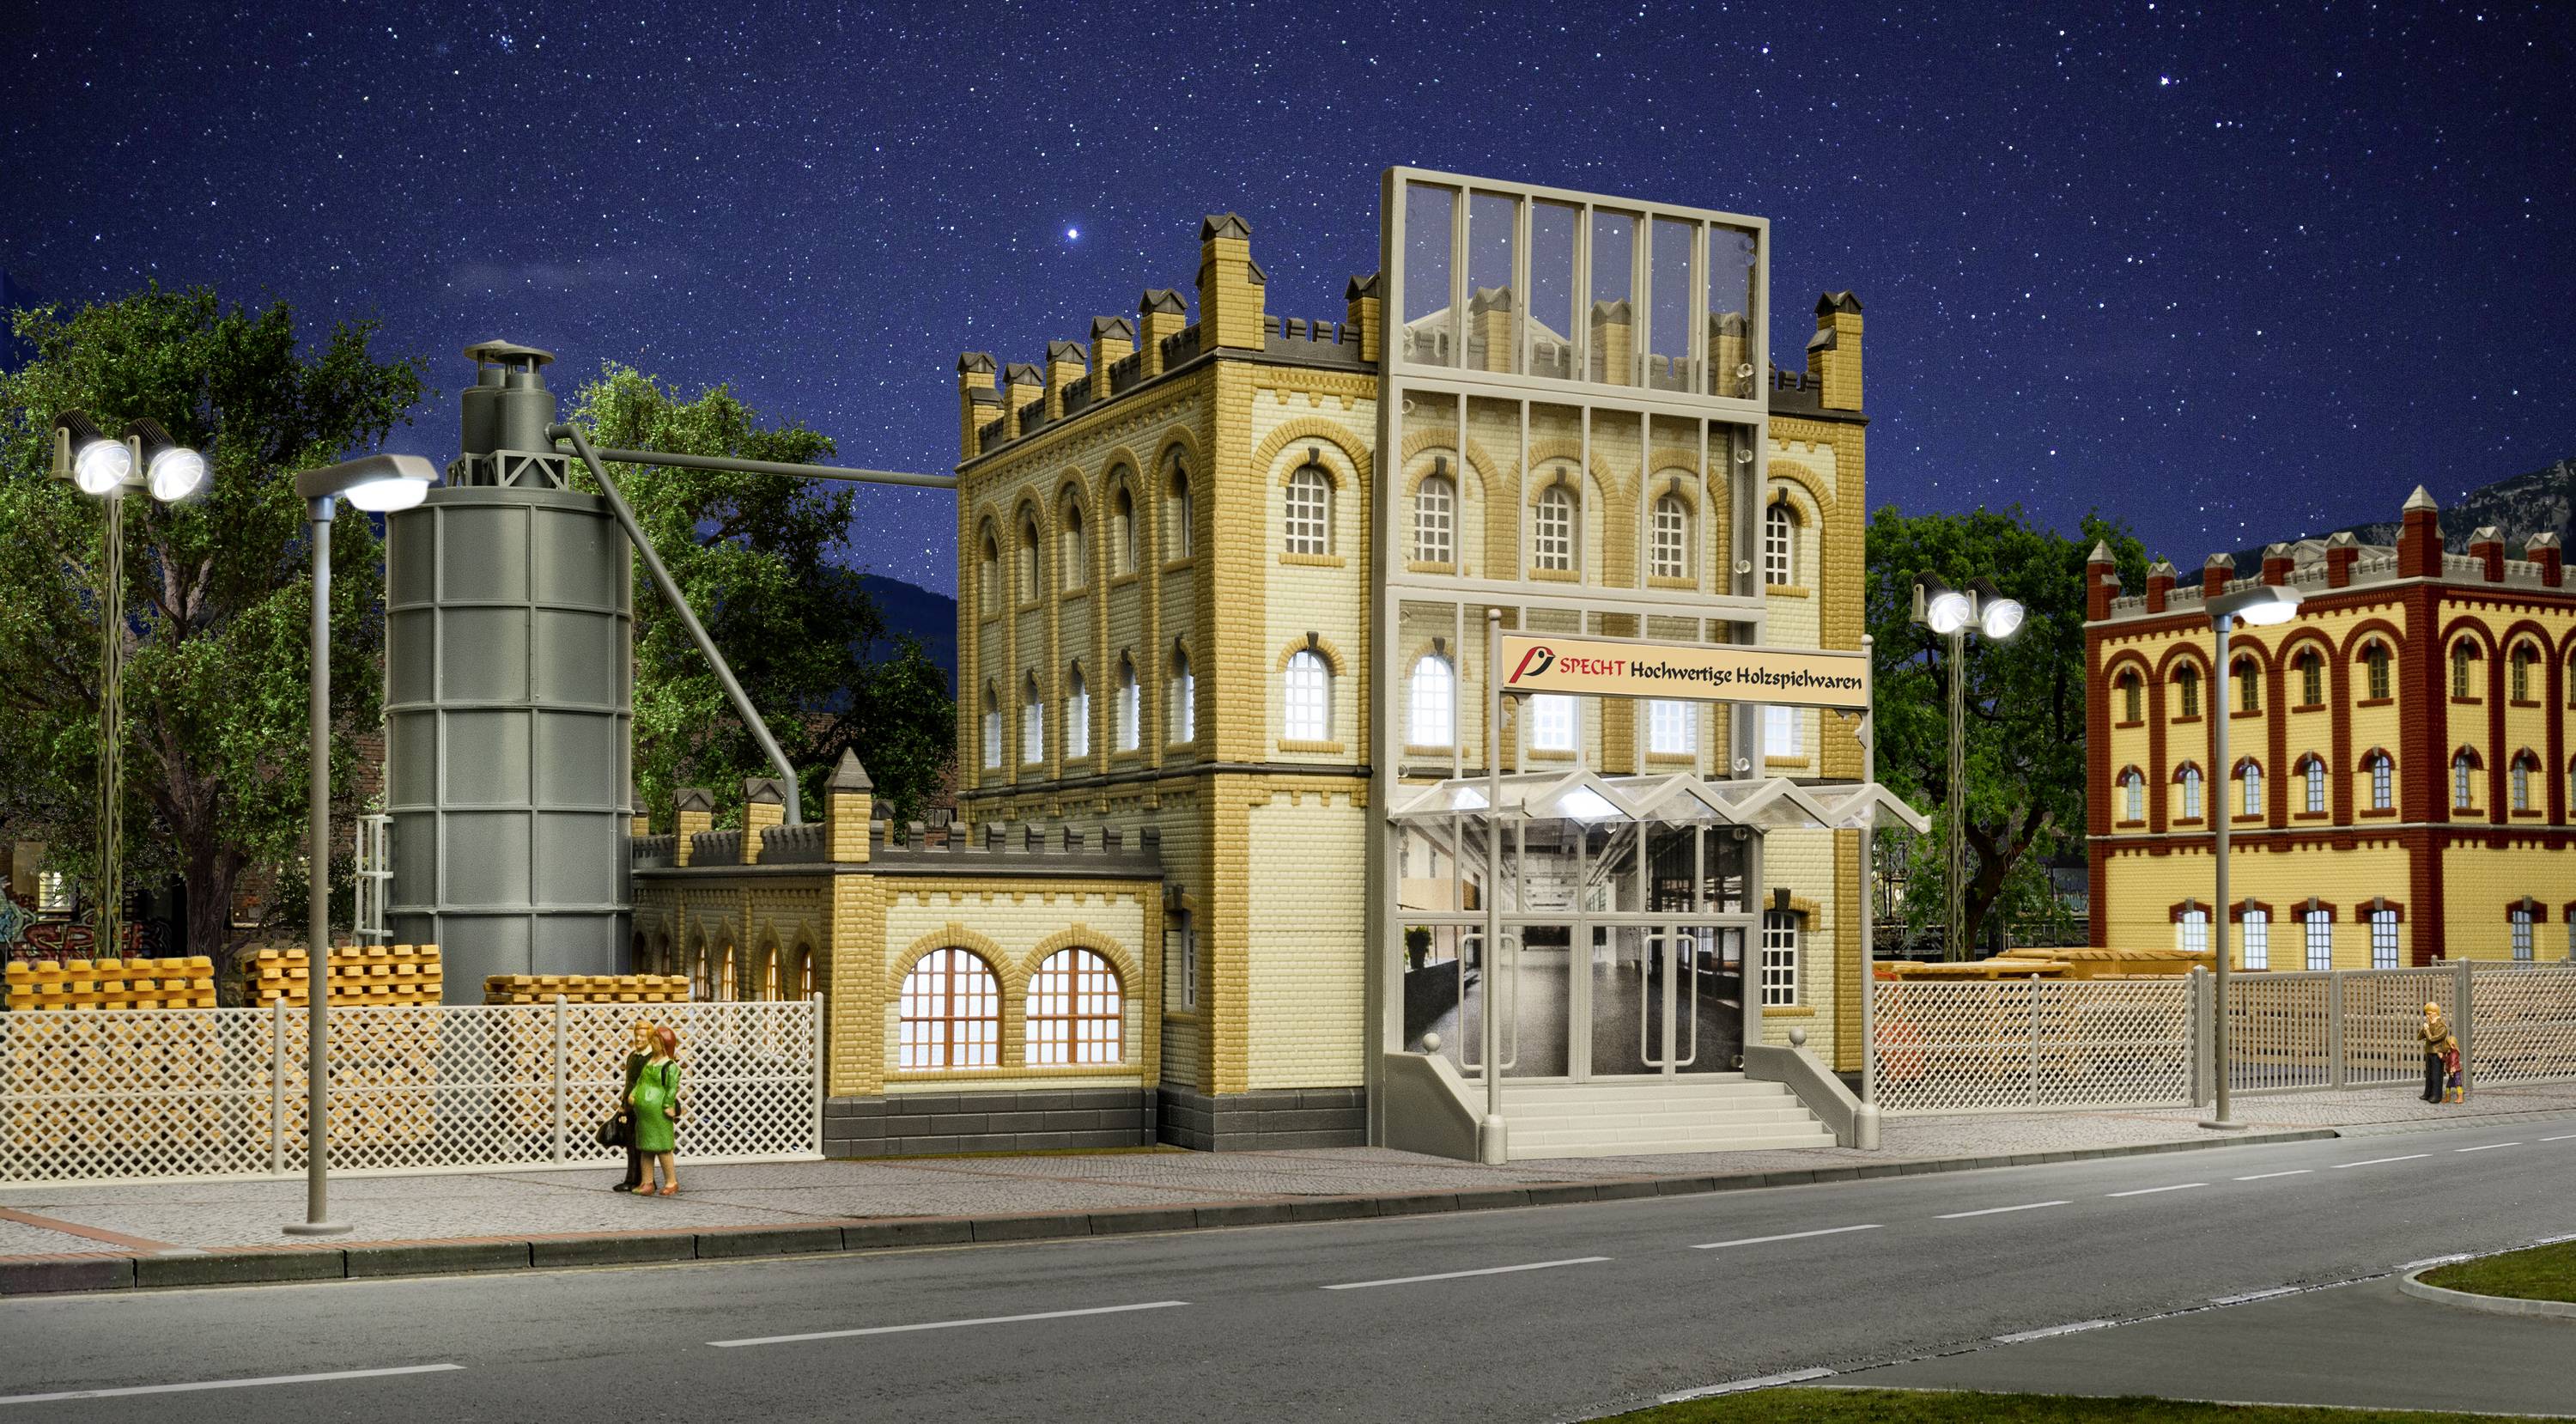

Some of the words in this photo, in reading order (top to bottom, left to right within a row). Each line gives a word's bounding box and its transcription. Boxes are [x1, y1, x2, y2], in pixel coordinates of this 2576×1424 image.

[1559, 657, 1626, 677] SPECHT
[1631, 660, 1733, 687] Hochwertige
[1736, 666, 1862, 691] Holzspielwaren
